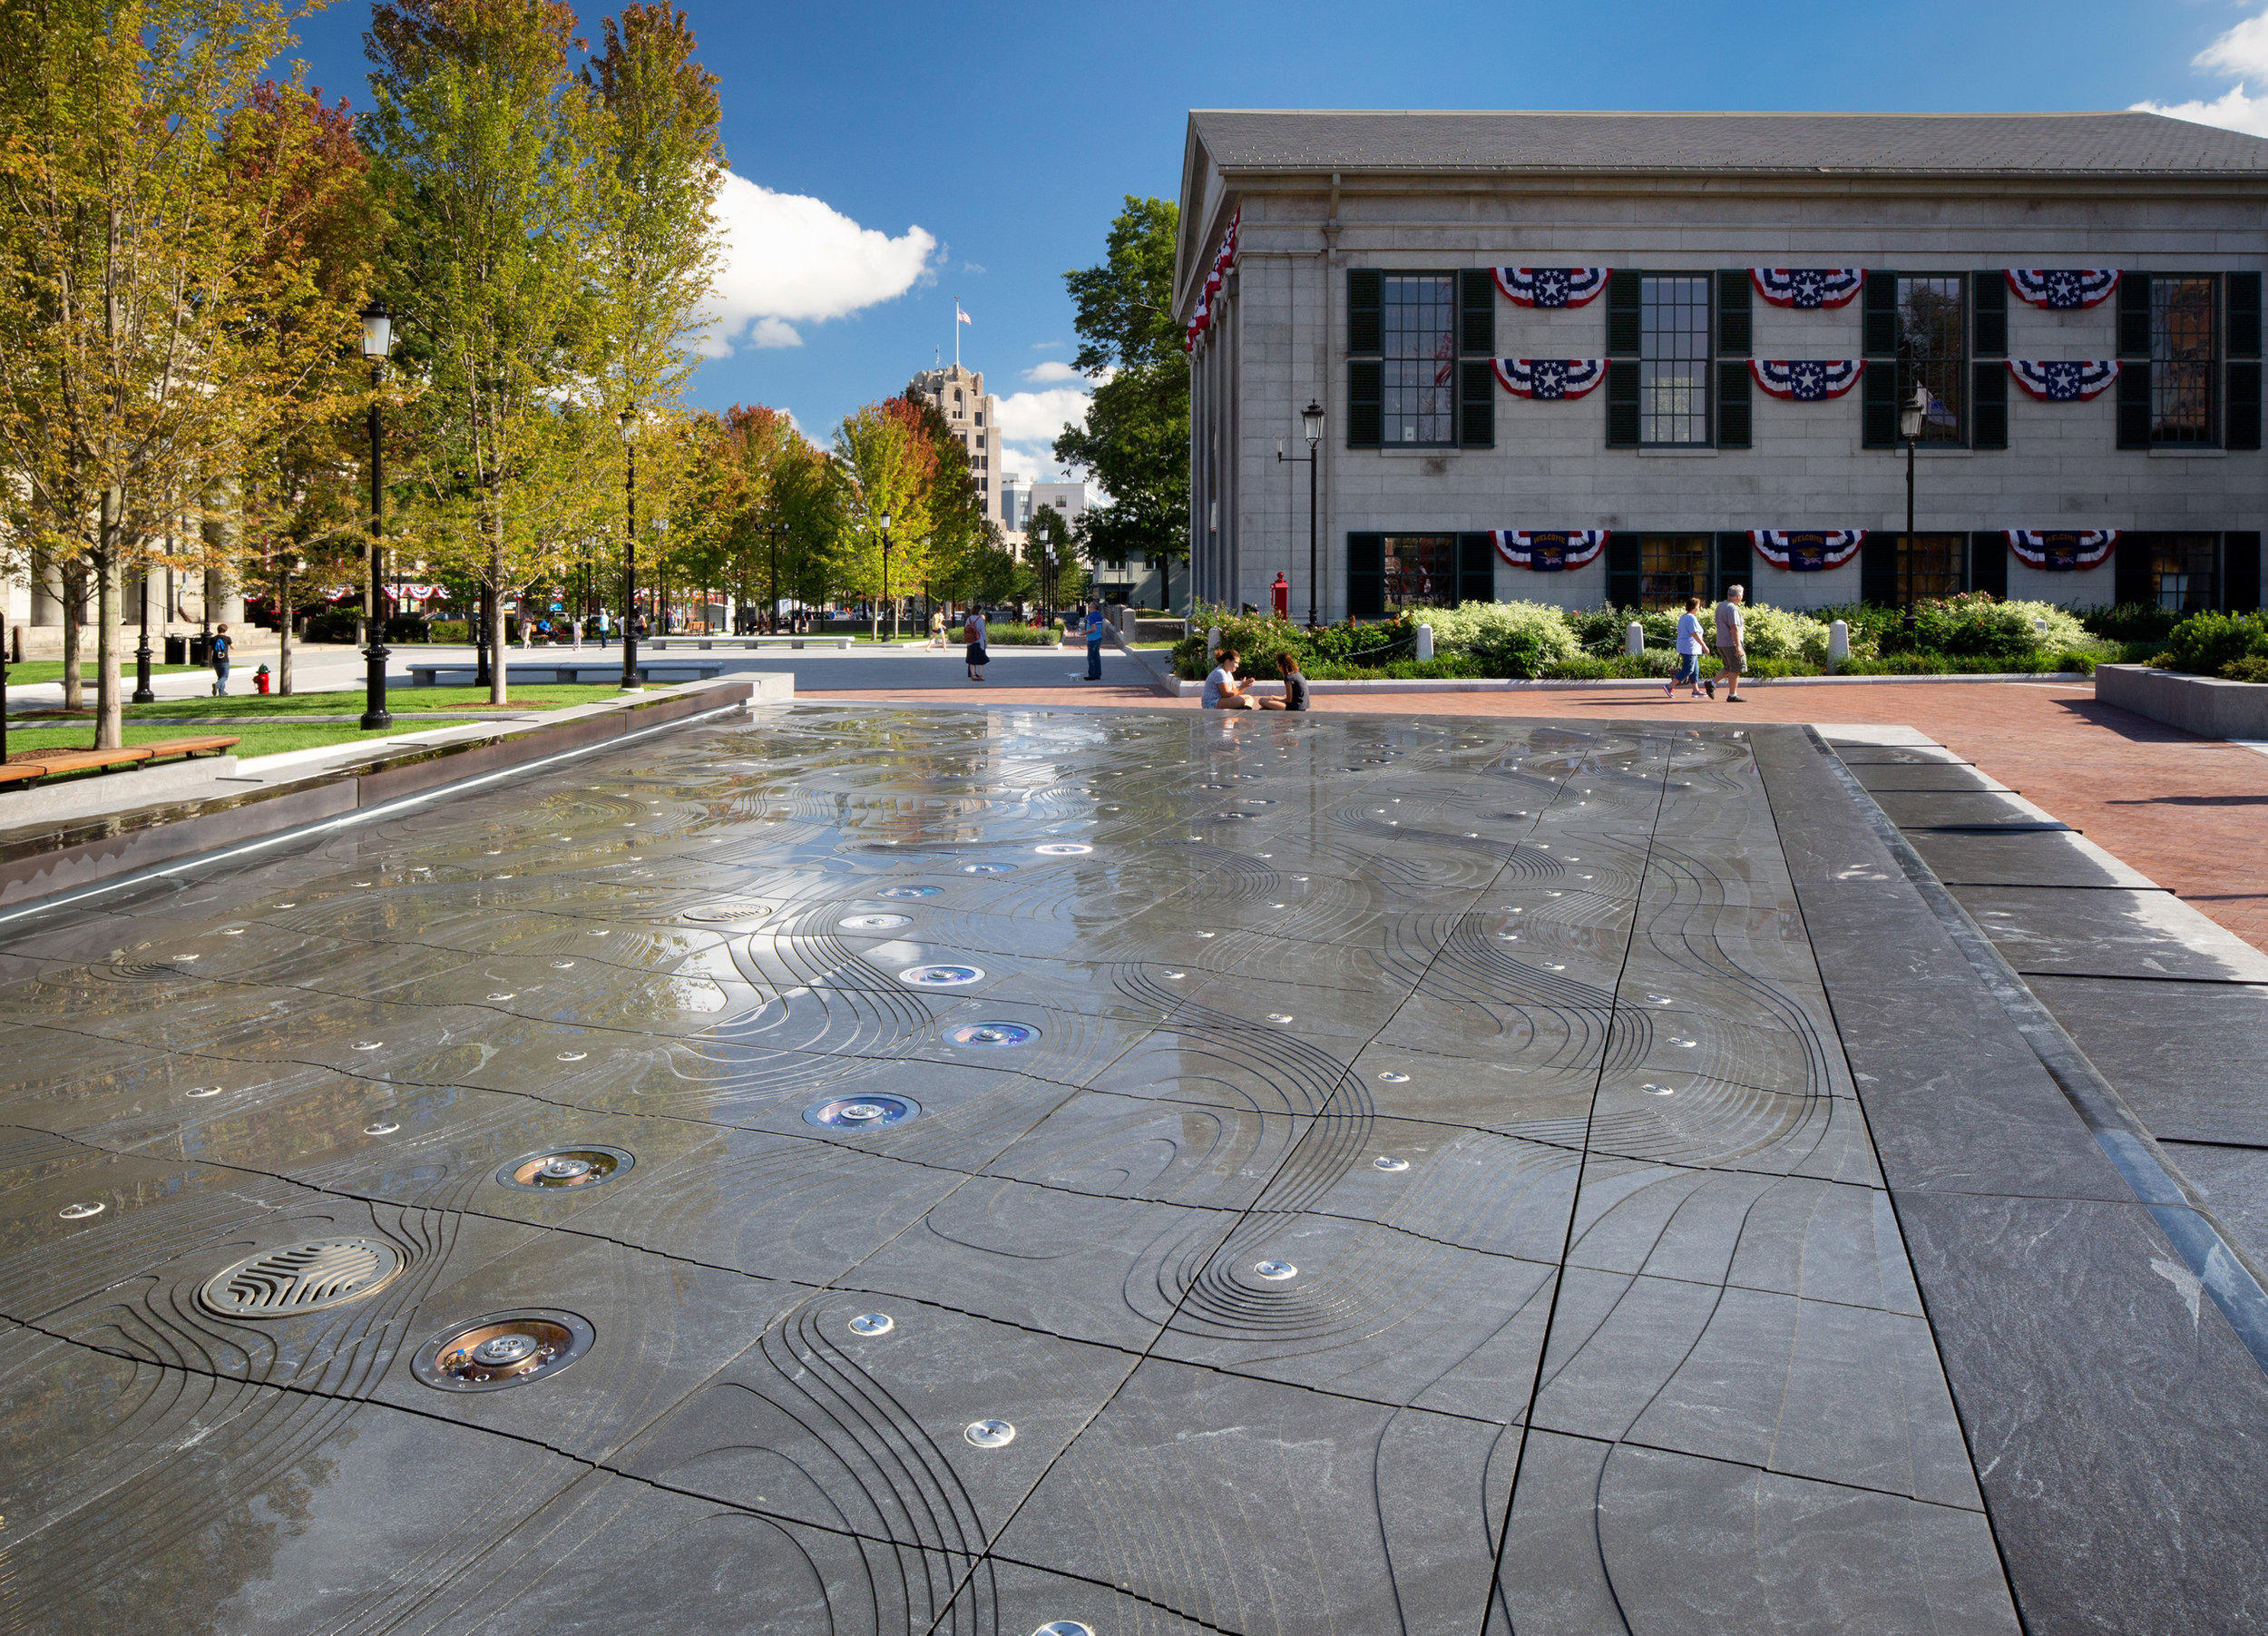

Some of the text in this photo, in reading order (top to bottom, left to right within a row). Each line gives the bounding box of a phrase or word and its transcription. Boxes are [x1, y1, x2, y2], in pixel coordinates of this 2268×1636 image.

[1533, 534, 1566, 544] WELCOME
[1792, 534, 1824, 544] WELCOME
[2046, 534, 2077, 544] WELCOME
